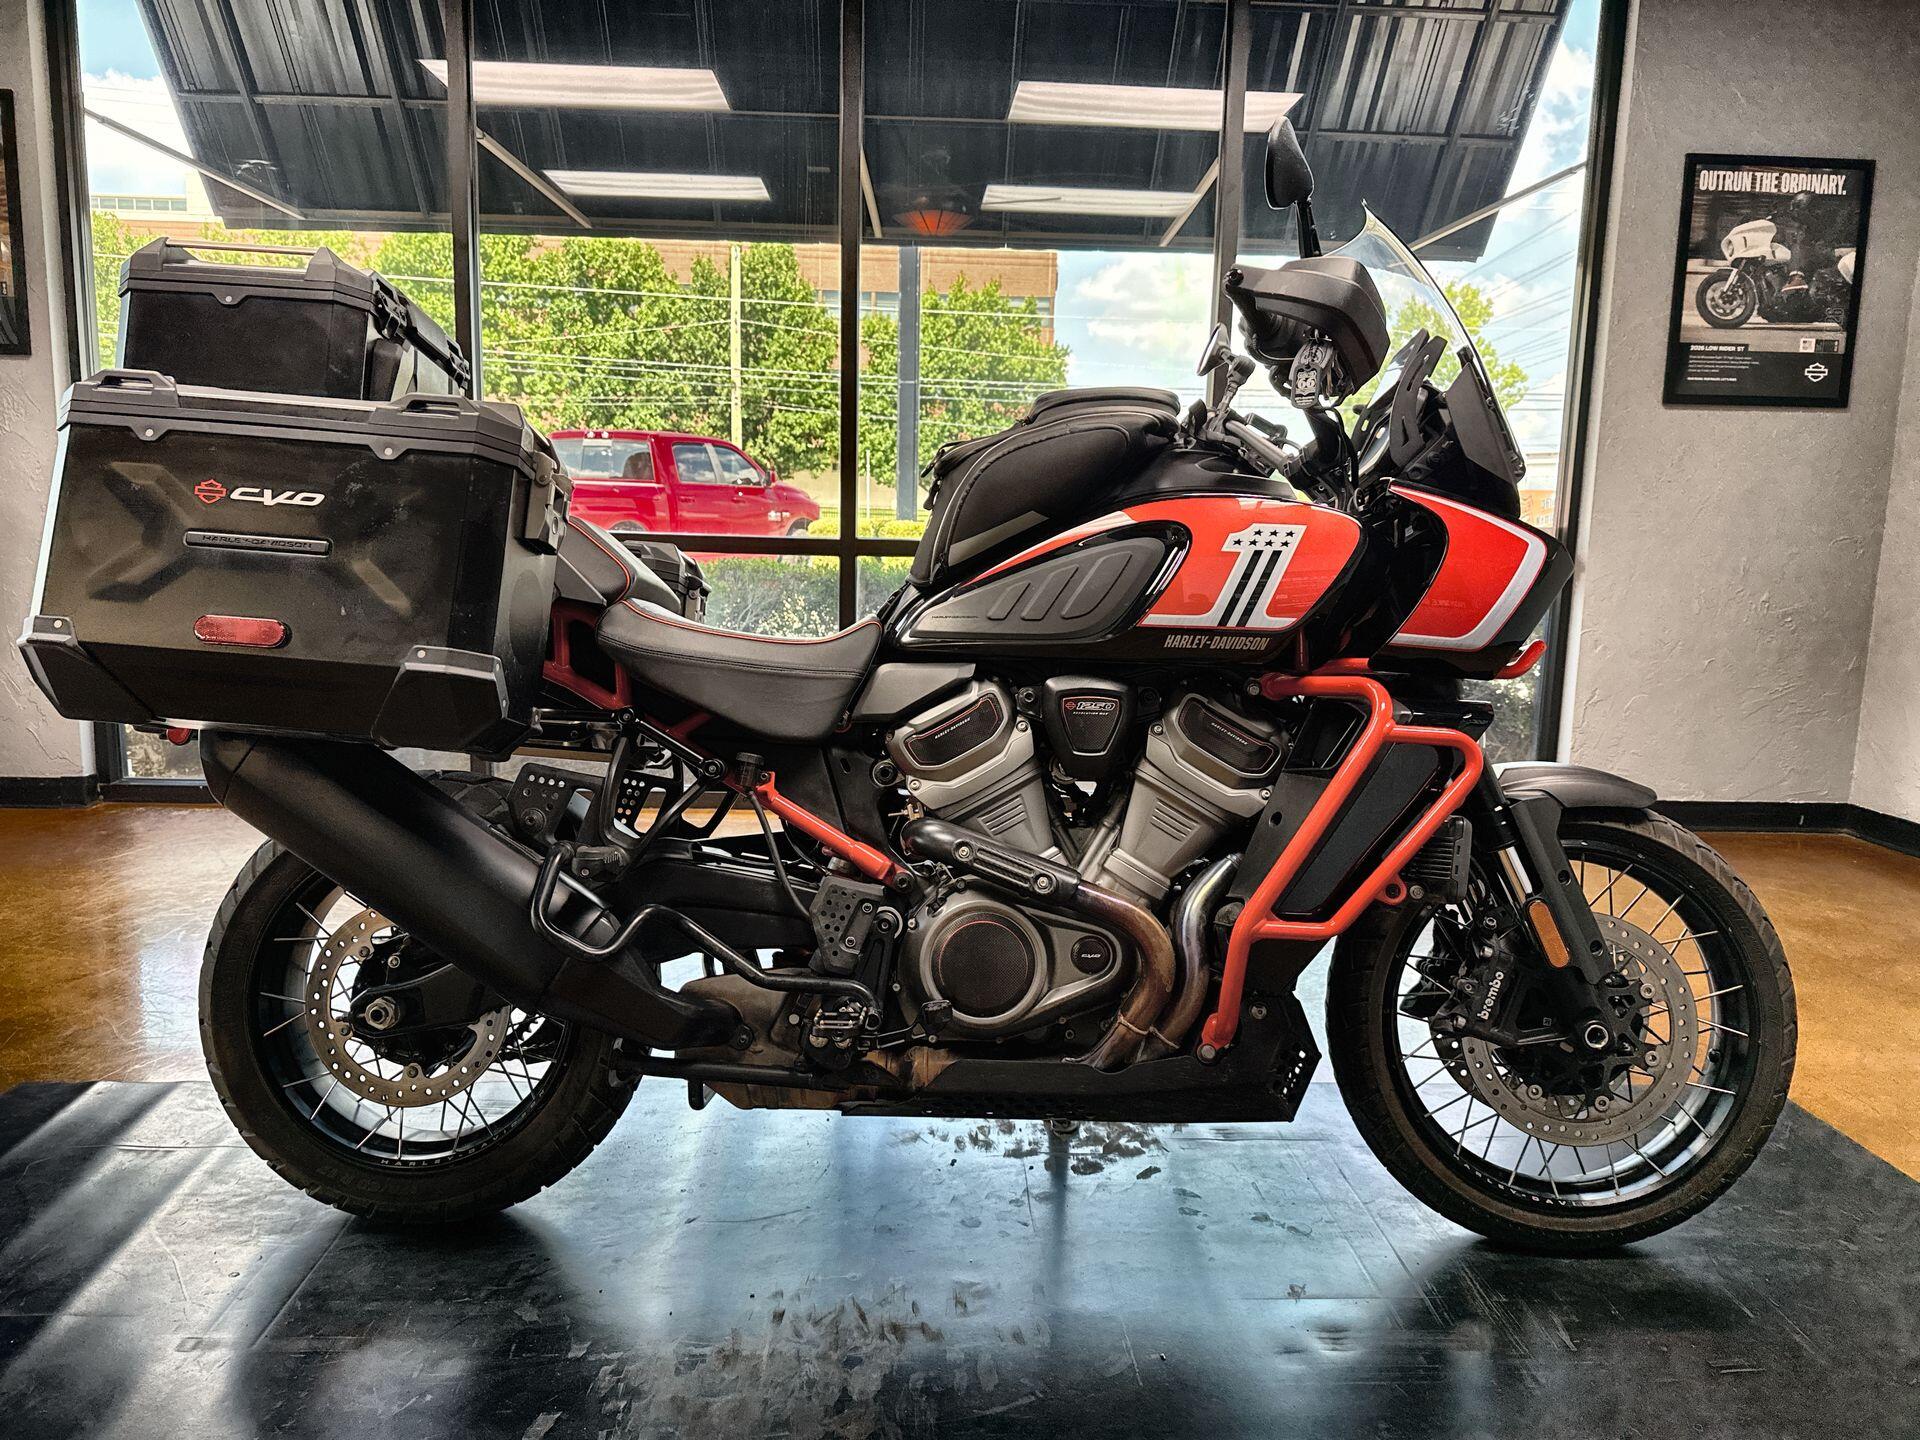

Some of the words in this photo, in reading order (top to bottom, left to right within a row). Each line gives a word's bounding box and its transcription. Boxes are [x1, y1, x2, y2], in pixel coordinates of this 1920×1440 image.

[1699, 170, 1753, 192] OUTRUN
[1755, 172, 1779, 193] THE
[1781, 172, 1846, 195] ORDINARY.
[230, 487, 326, 506] CVO
[1163, 634, 1271, 650] HARLEY-DAVIDSON
[1076, 701, 1116, 711] 1250
[1476, 971, 1505, 1020] brembo
